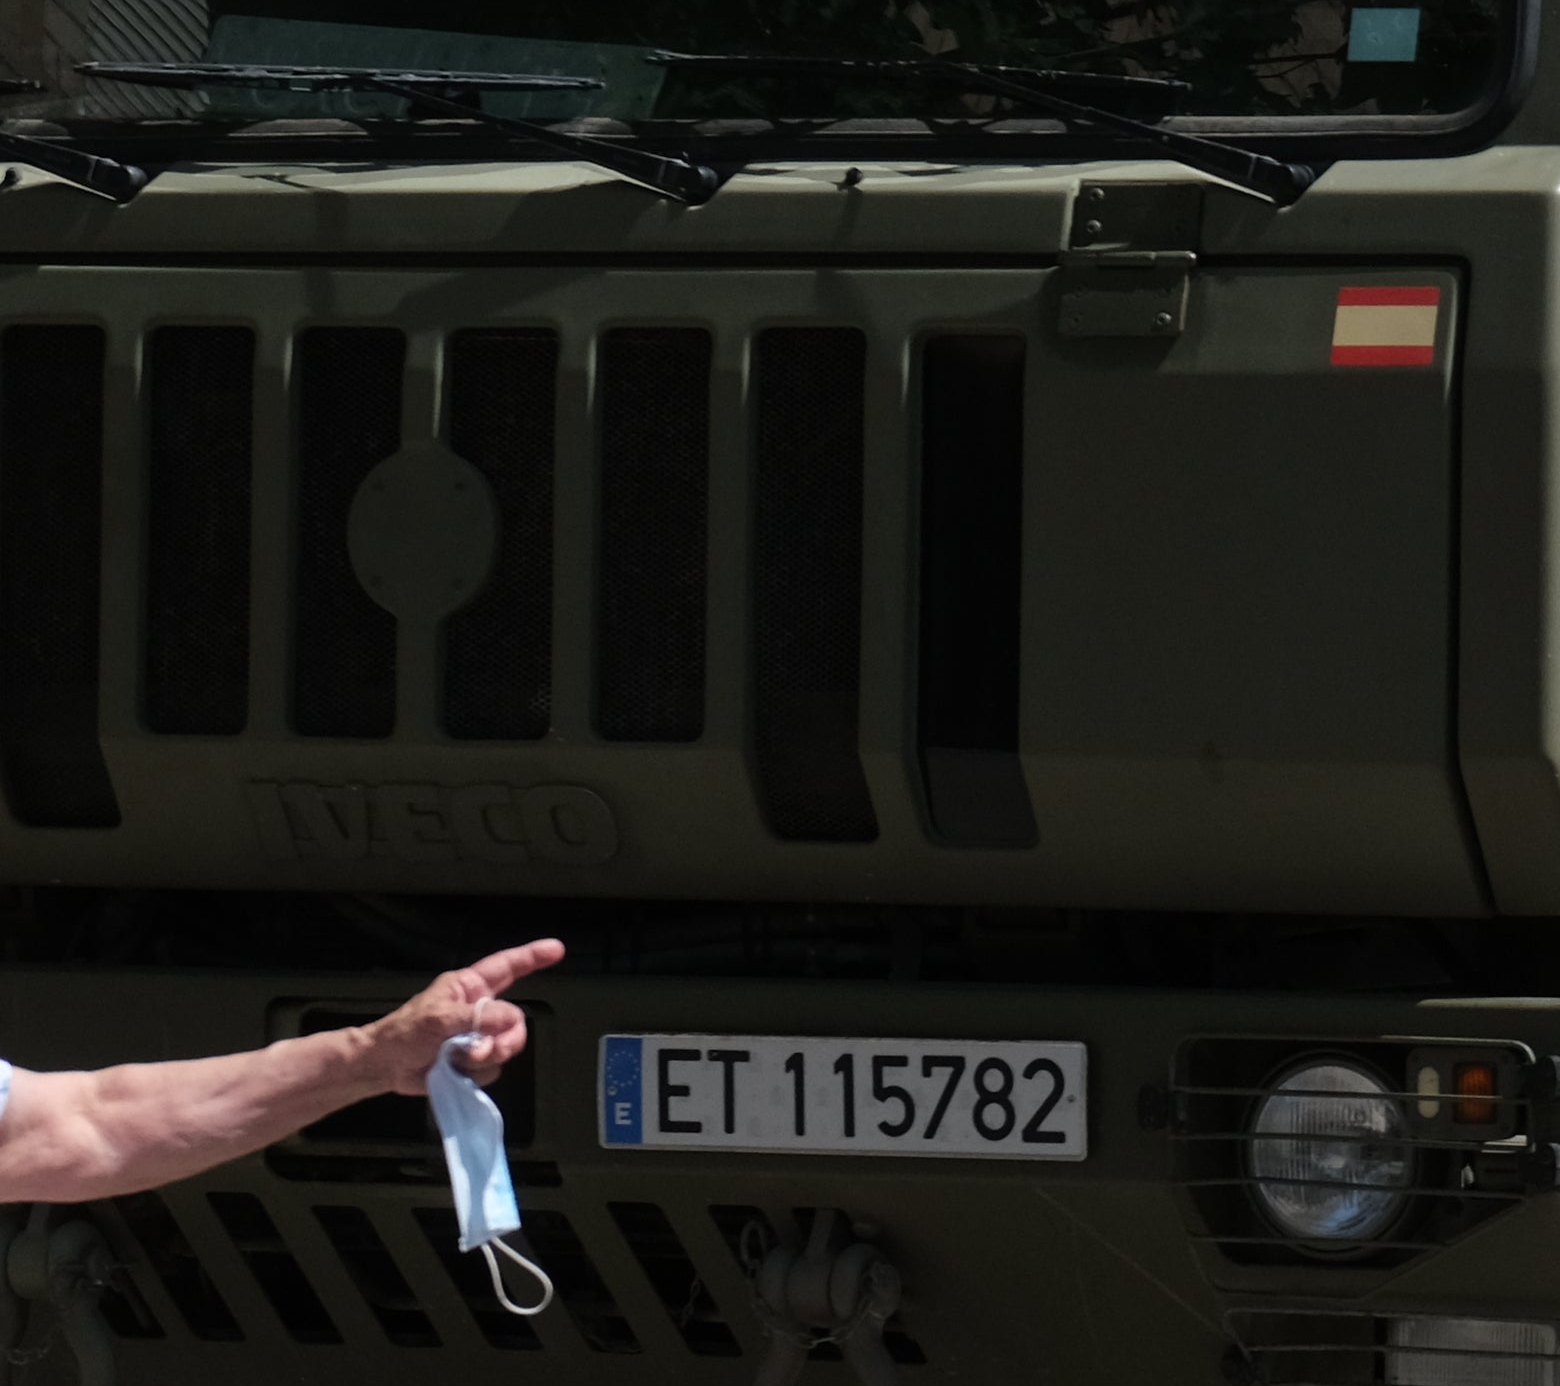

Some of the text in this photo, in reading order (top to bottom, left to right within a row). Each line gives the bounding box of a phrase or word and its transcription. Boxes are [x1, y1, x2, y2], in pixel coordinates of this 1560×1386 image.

[244, 777, 620, 865] IVECO
[614, 1101, 633, 1126] E
[657, 1048, 1067, 1144] ET 115782
